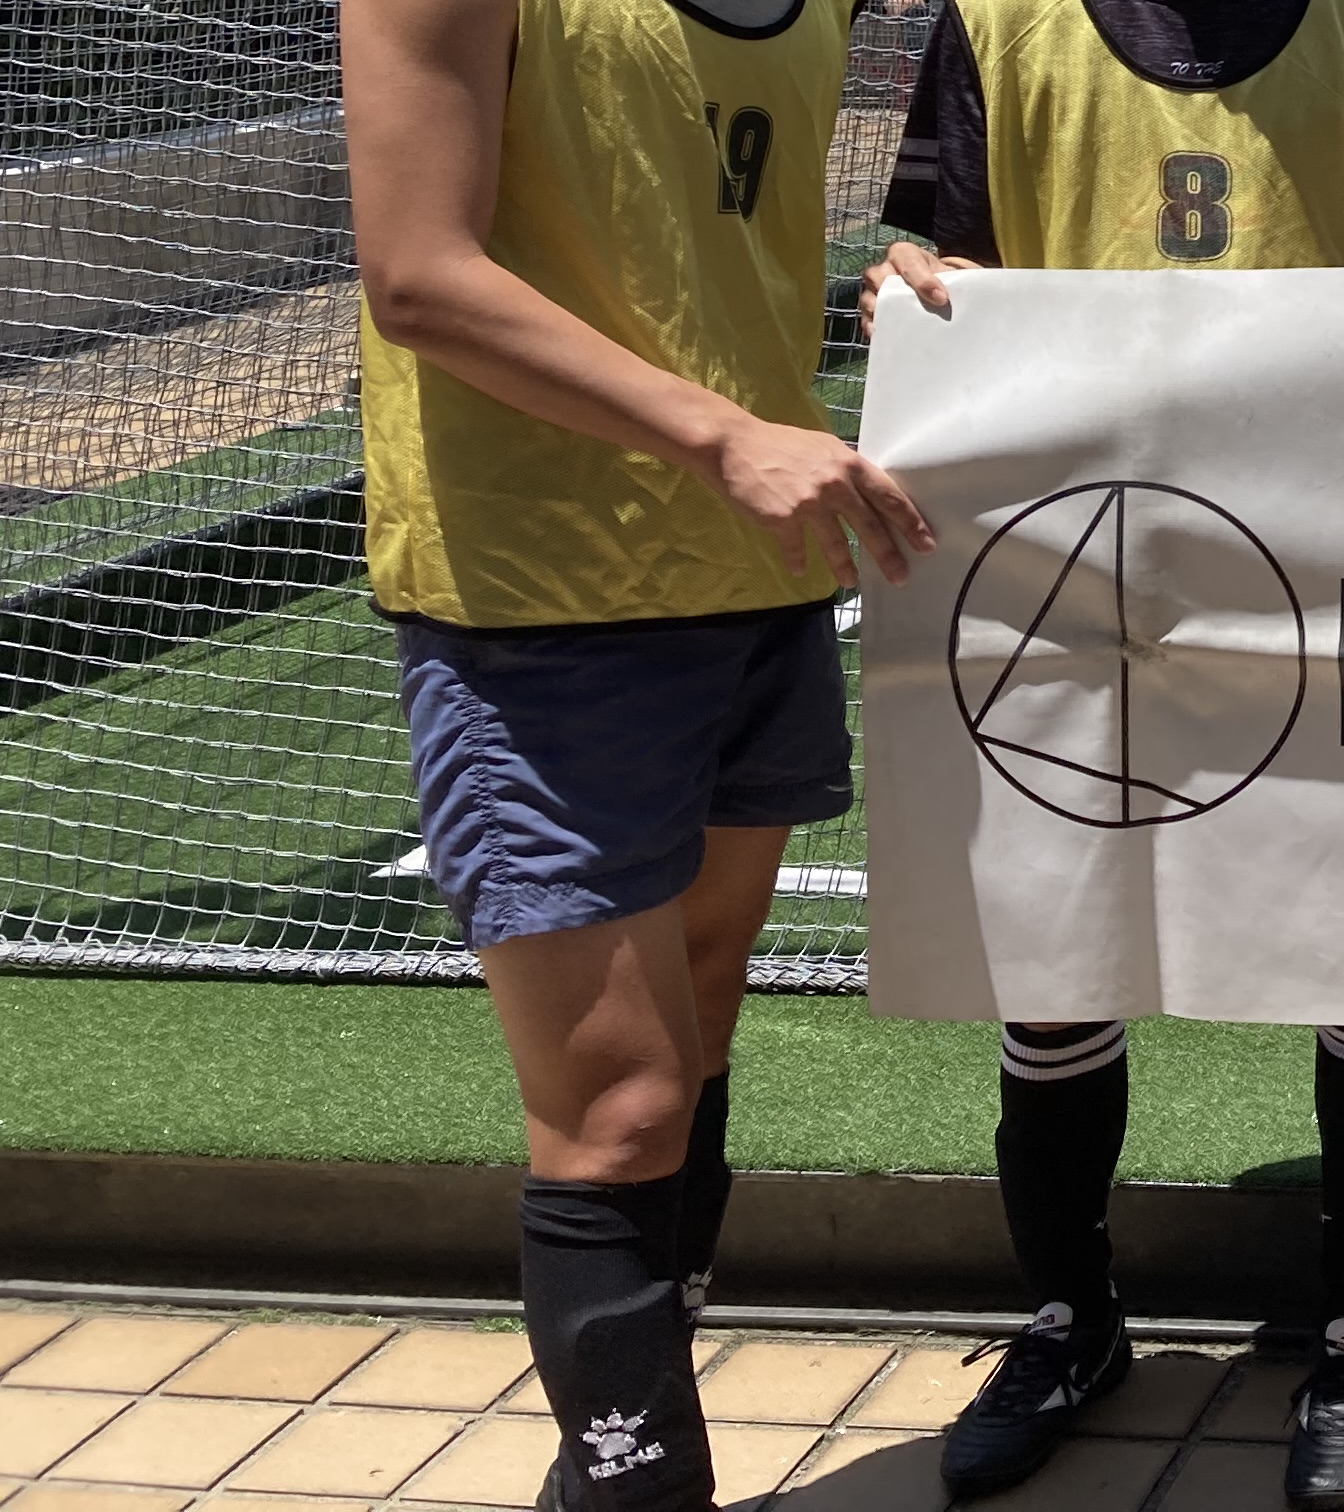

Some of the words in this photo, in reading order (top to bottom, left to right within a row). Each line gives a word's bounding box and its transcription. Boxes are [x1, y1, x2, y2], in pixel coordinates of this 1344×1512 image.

[1170, 61, 1191, 75] TO
[702, 100, 774, 224] 19
[1155, 150, 1234, 264] 8
